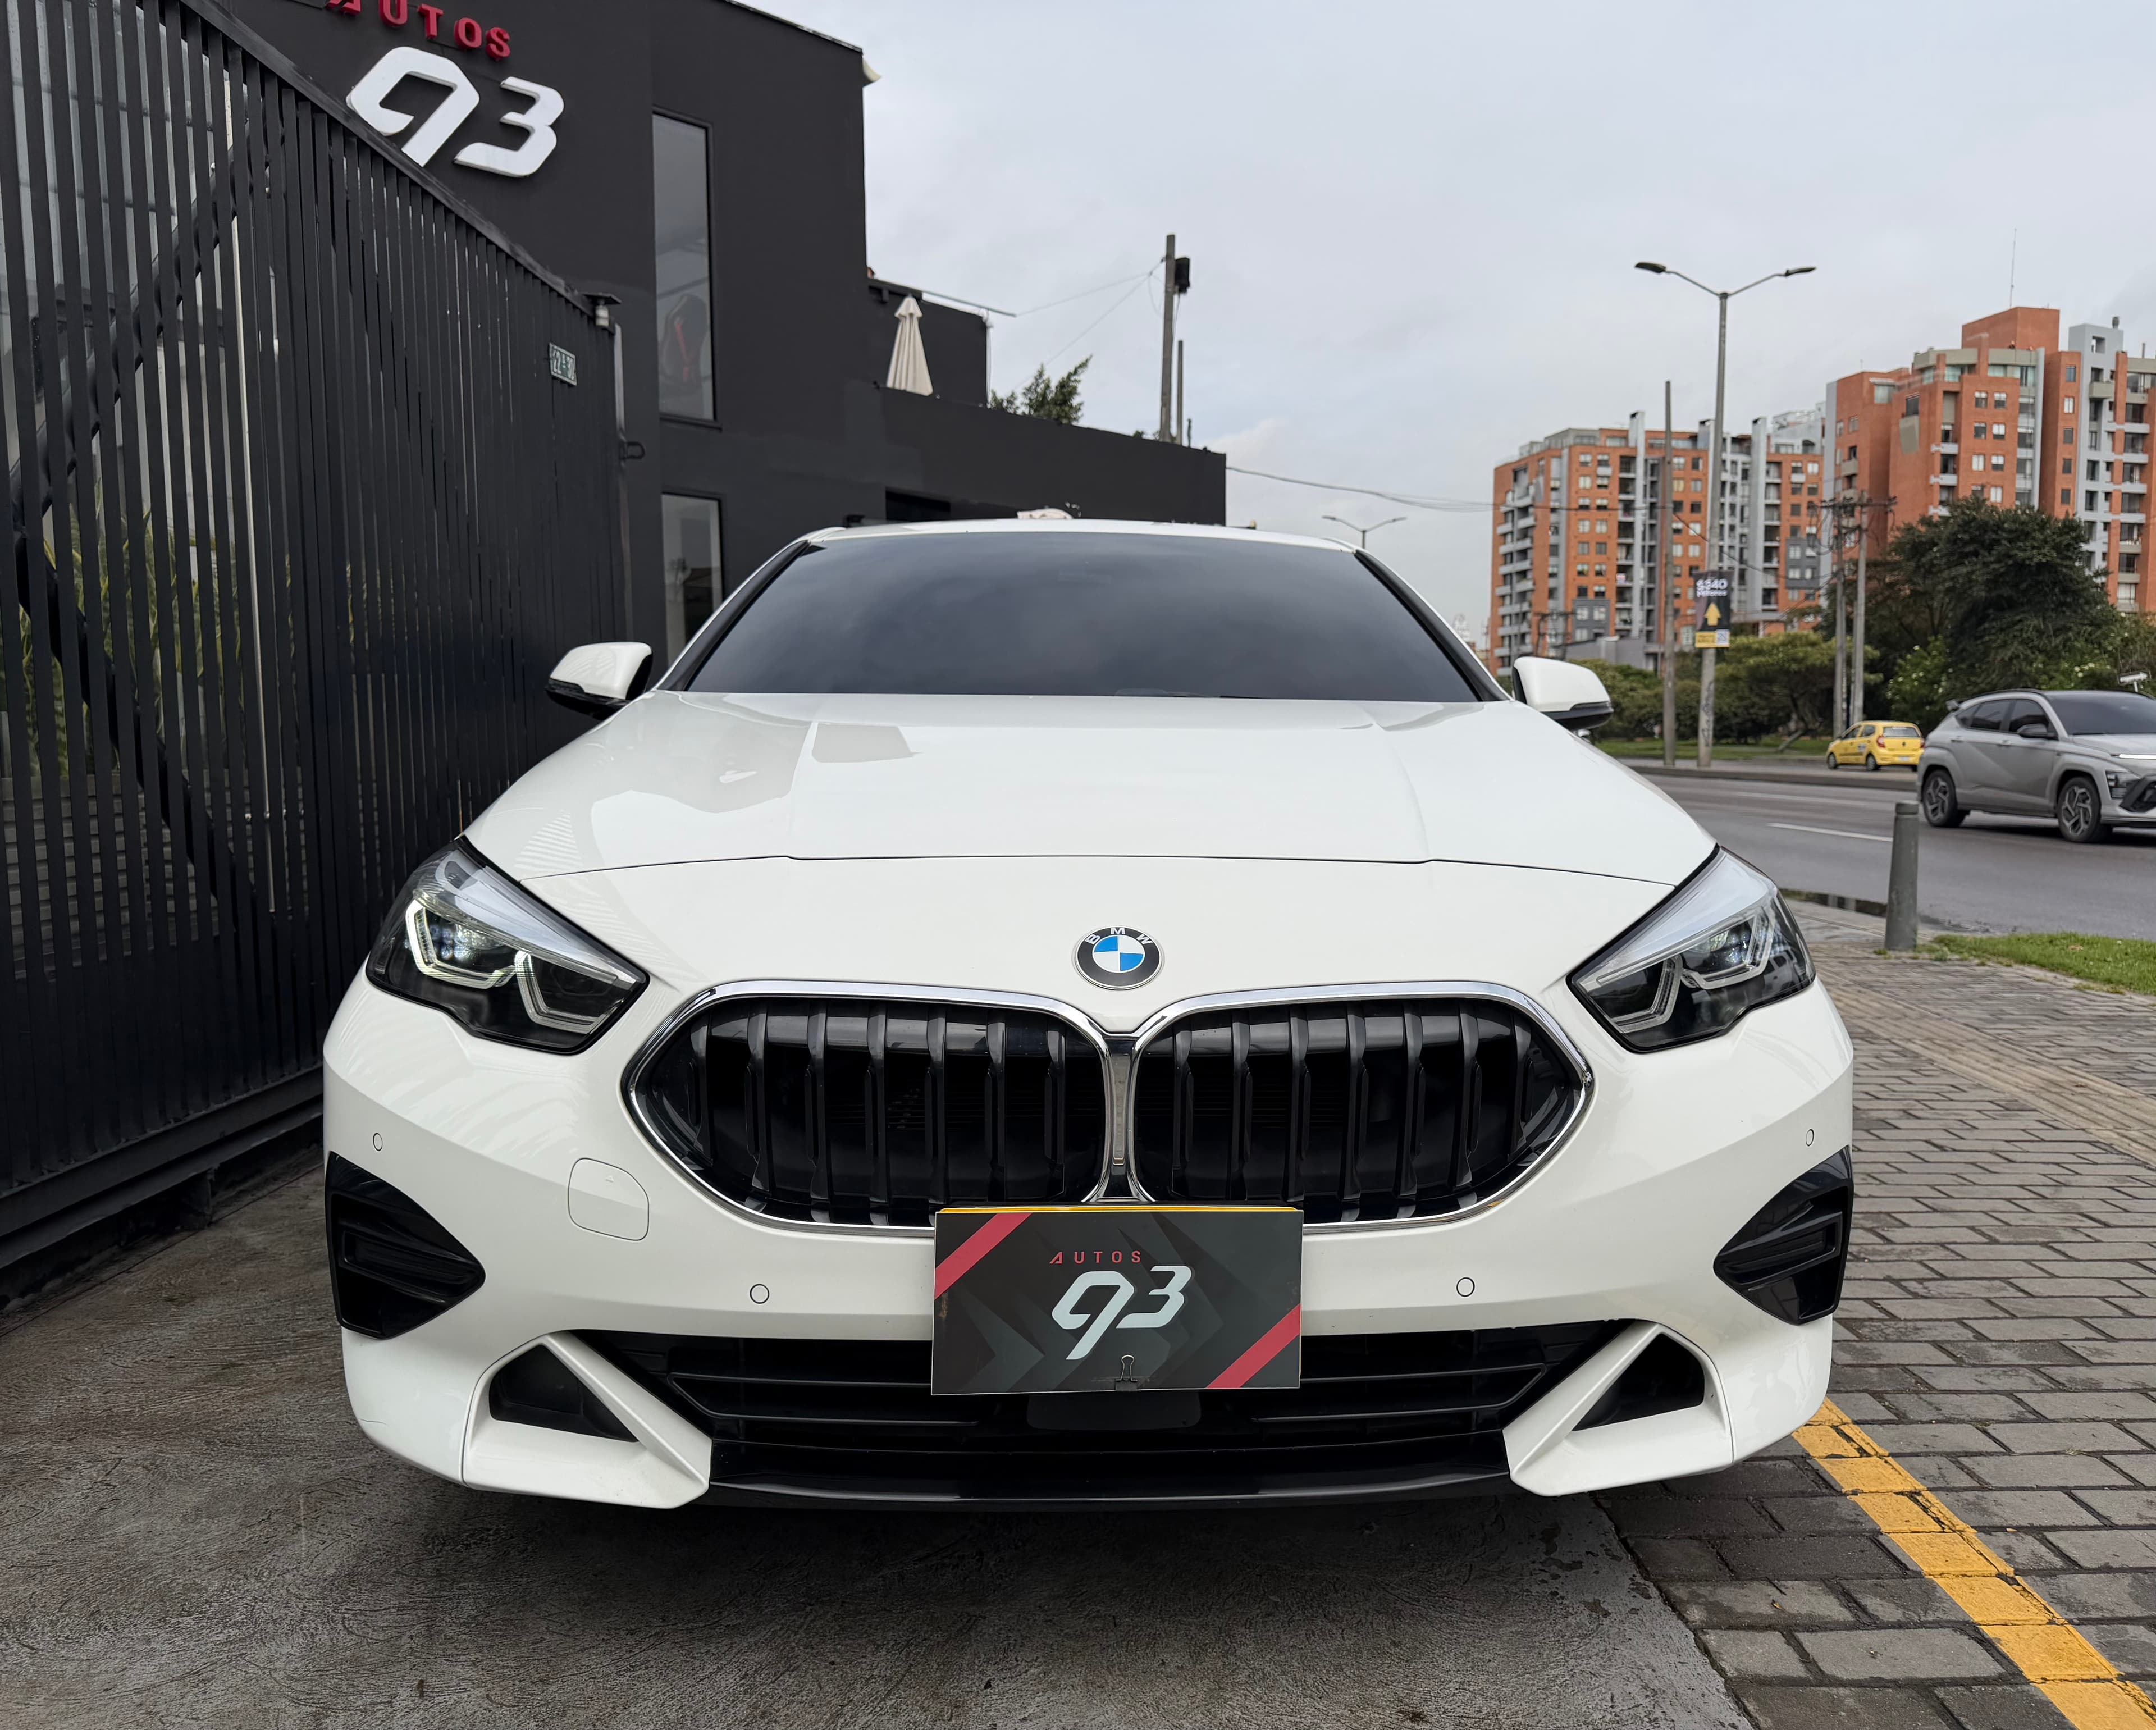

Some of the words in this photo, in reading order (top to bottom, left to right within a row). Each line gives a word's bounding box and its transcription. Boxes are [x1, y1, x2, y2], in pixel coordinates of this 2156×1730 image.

[346, 47, 565, 177] 93
[1085, 928, 1153, 944] BMW
[1049, 1250, 1141, 1264] AUTOS
[1052, 1265, 1193, 1360] 93
